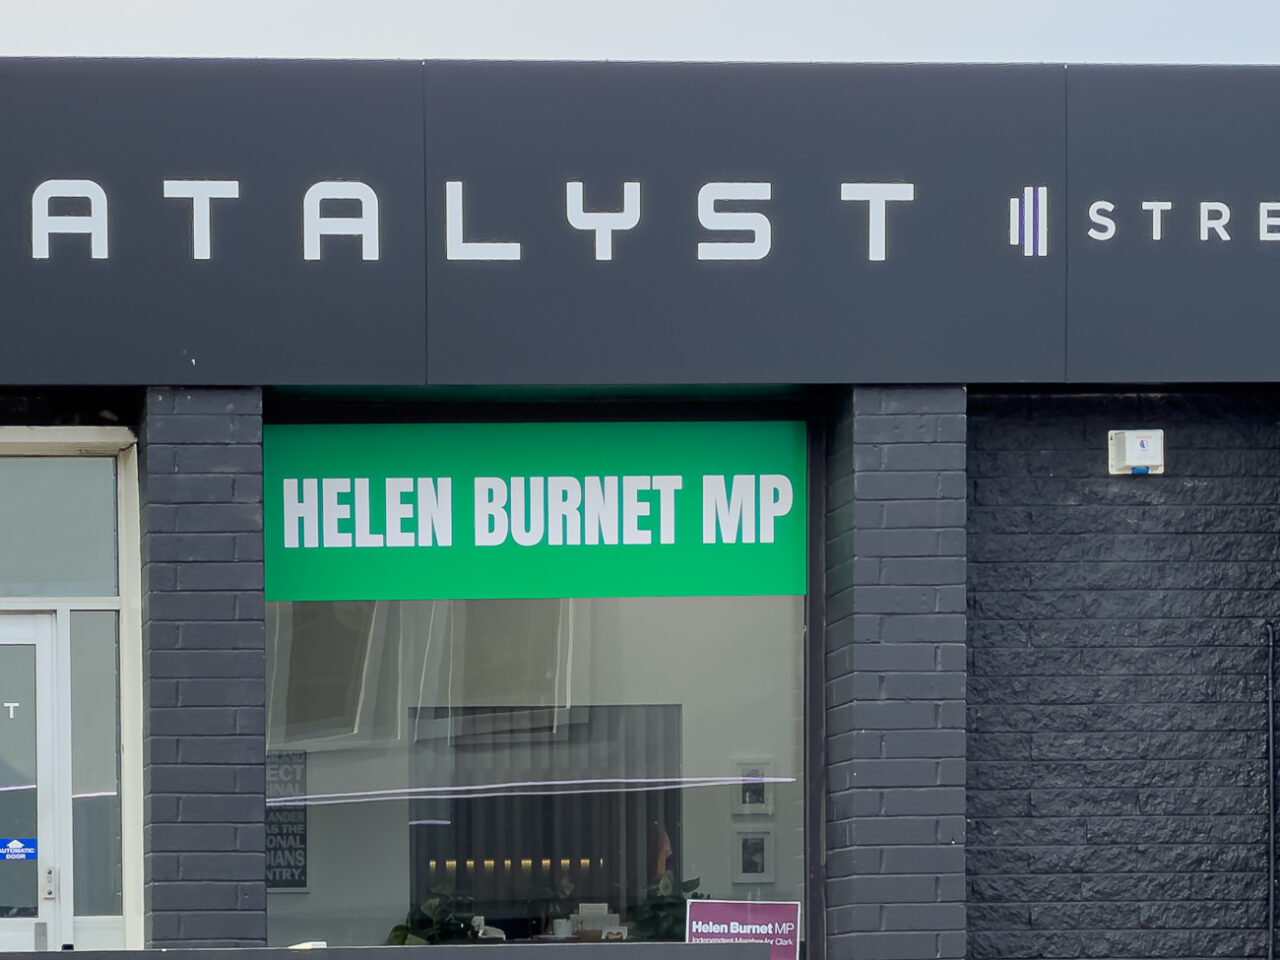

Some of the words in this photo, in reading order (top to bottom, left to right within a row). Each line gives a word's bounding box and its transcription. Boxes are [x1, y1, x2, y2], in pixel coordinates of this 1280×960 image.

[30, 177, 918, 262] ATALYST
[282, 476, 453, 548] HELEN
[474, 474, 683, 547] BURNET
[702, 473, 794, 545] MP
[282, 825, 305, 833] THE
[691, 921, 728, 933] Helen
[730, 921, 773, 934] Burnet
[774, 923, 795, 934] MP
